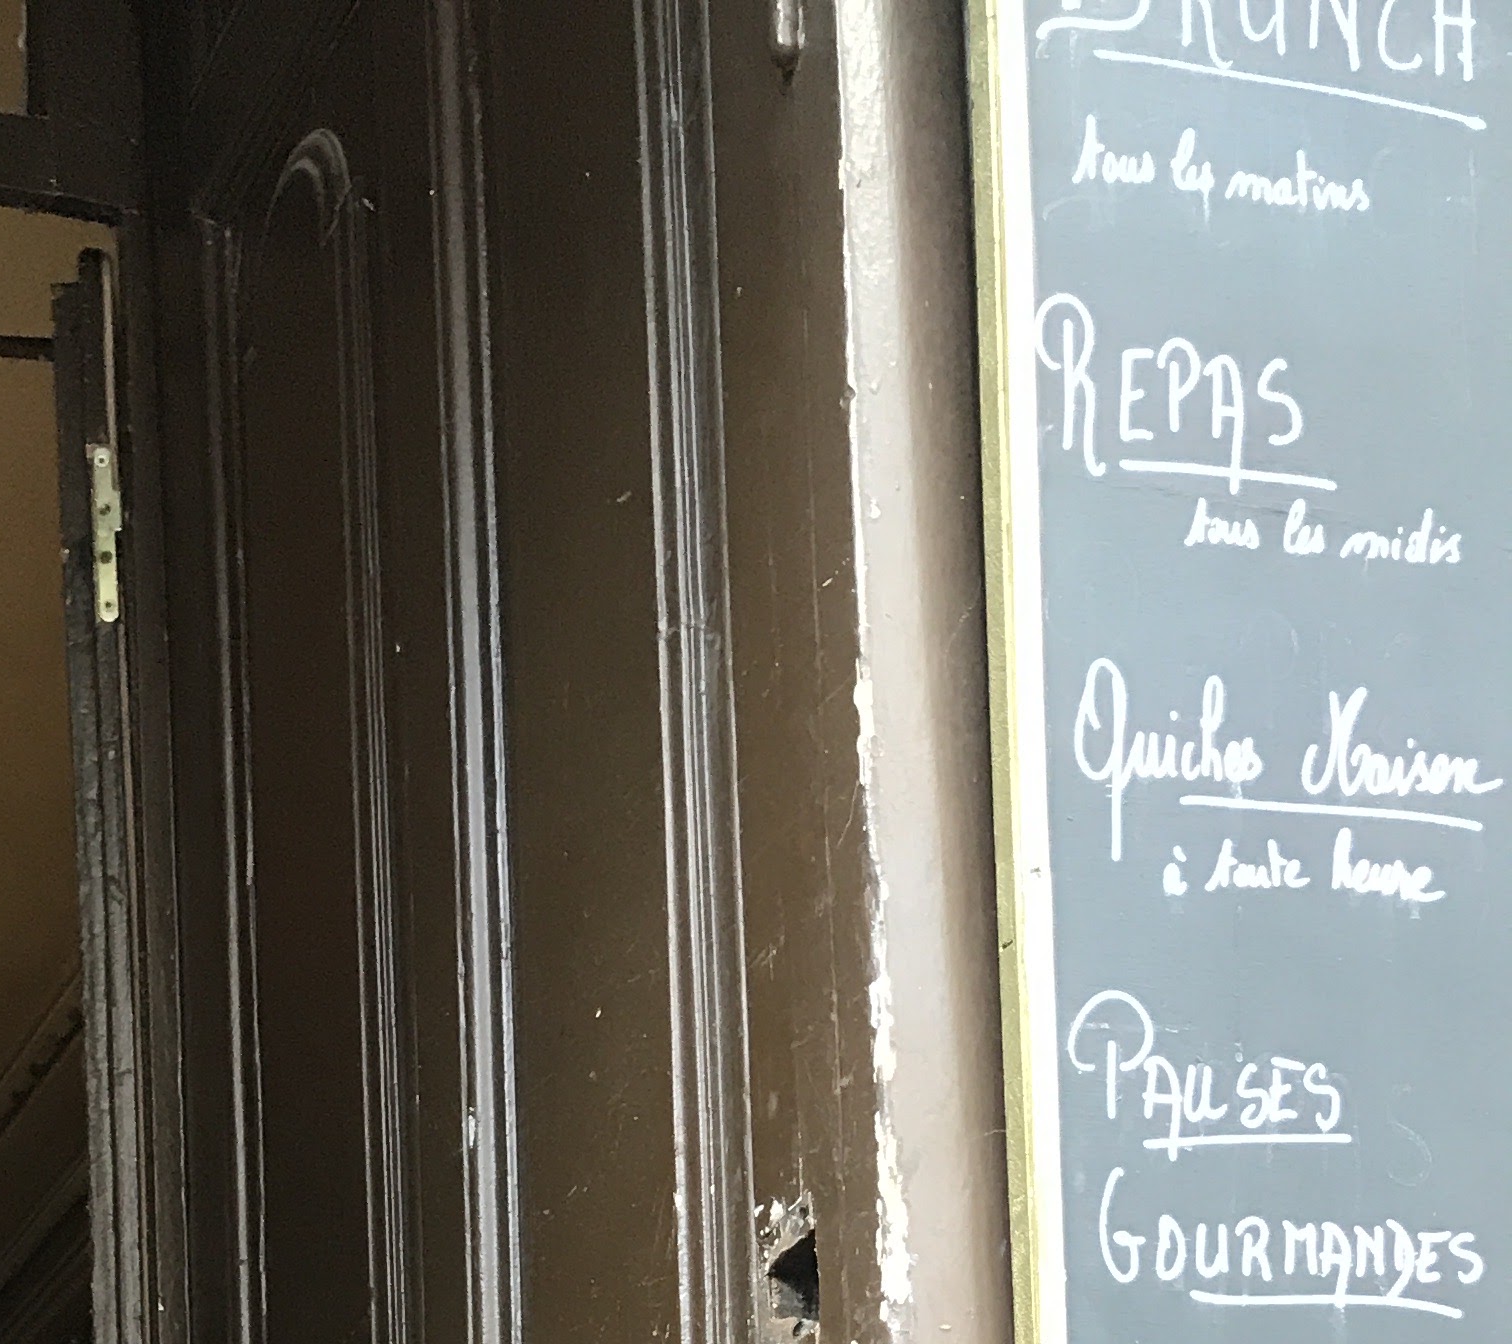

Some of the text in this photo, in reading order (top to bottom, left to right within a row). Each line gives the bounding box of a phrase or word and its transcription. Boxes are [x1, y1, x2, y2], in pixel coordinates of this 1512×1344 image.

[1072, 113, 1156, 184] tous
[1225, 149, 1371, 212] matins
[1034, 292, 1305, 494] REPAS
[1183, 498, 1463, 565] tous les midis
[1074, 657, 1505, 861] Quiches Maison
[1204, 838, 1310, 892] toute
[1331, 827, 1447, 902] heure
[1067, 990, 1341, 1160] PAUSES
[1099, 1167, 1484, 1298] GOURMANDES
